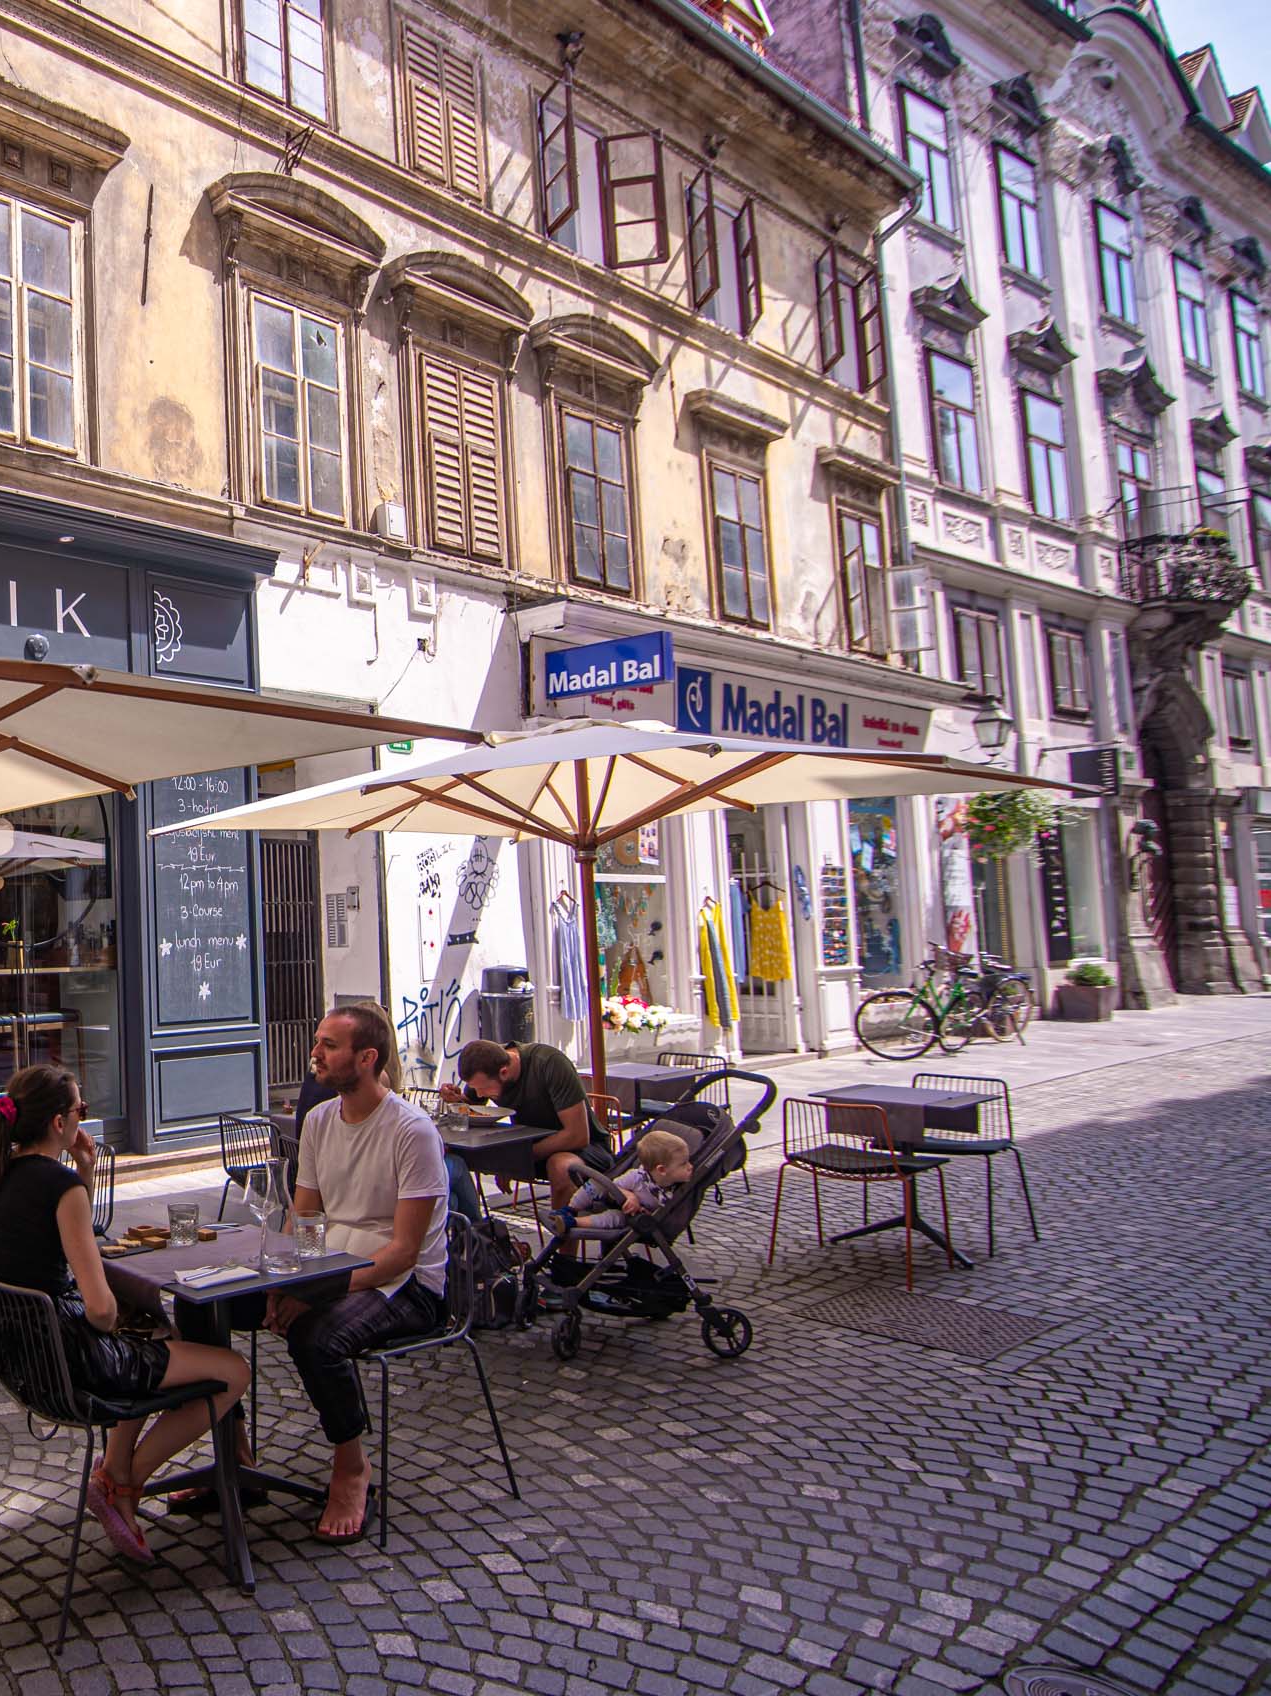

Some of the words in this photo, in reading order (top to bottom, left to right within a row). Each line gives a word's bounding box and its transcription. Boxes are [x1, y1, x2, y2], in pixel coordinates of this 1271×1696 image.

[548, 662, 616, 694] Madal
[623, 654, 661, 683] Bal
[722, 683, 805, 741] Madal
[811, 698, 848, 747] Bal
[205, 776, 229, 793] 16:00
